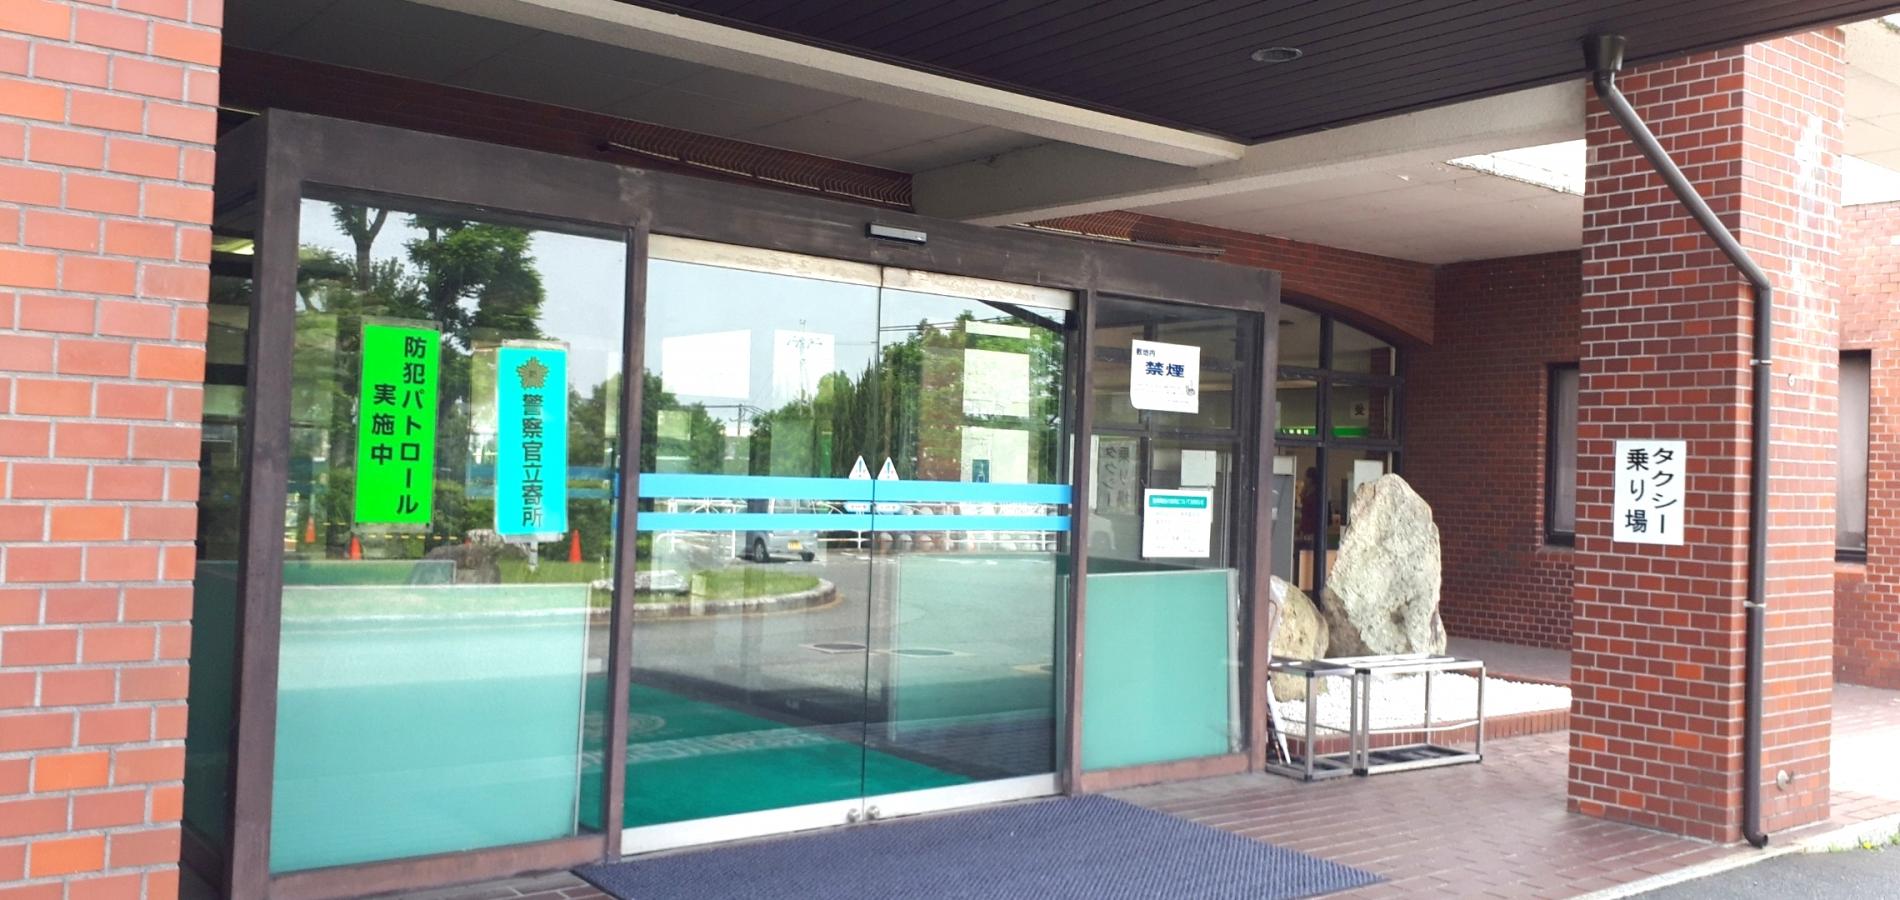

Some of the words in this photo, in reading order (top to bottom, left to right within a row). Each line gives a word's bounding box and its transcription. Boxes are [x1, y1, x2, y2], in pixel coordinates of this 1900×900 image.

[1145, 361, 1185, 378] 禁煙
[370, 383, 397, 465] 実施中
[397, 336, 427, 515] 防犯パトロール
[521, 394, 543, 527] 警察官立寄所
[1625, 448, 1649, 533] 乗り場
[1652, 447, 1677, 534] タクシー
